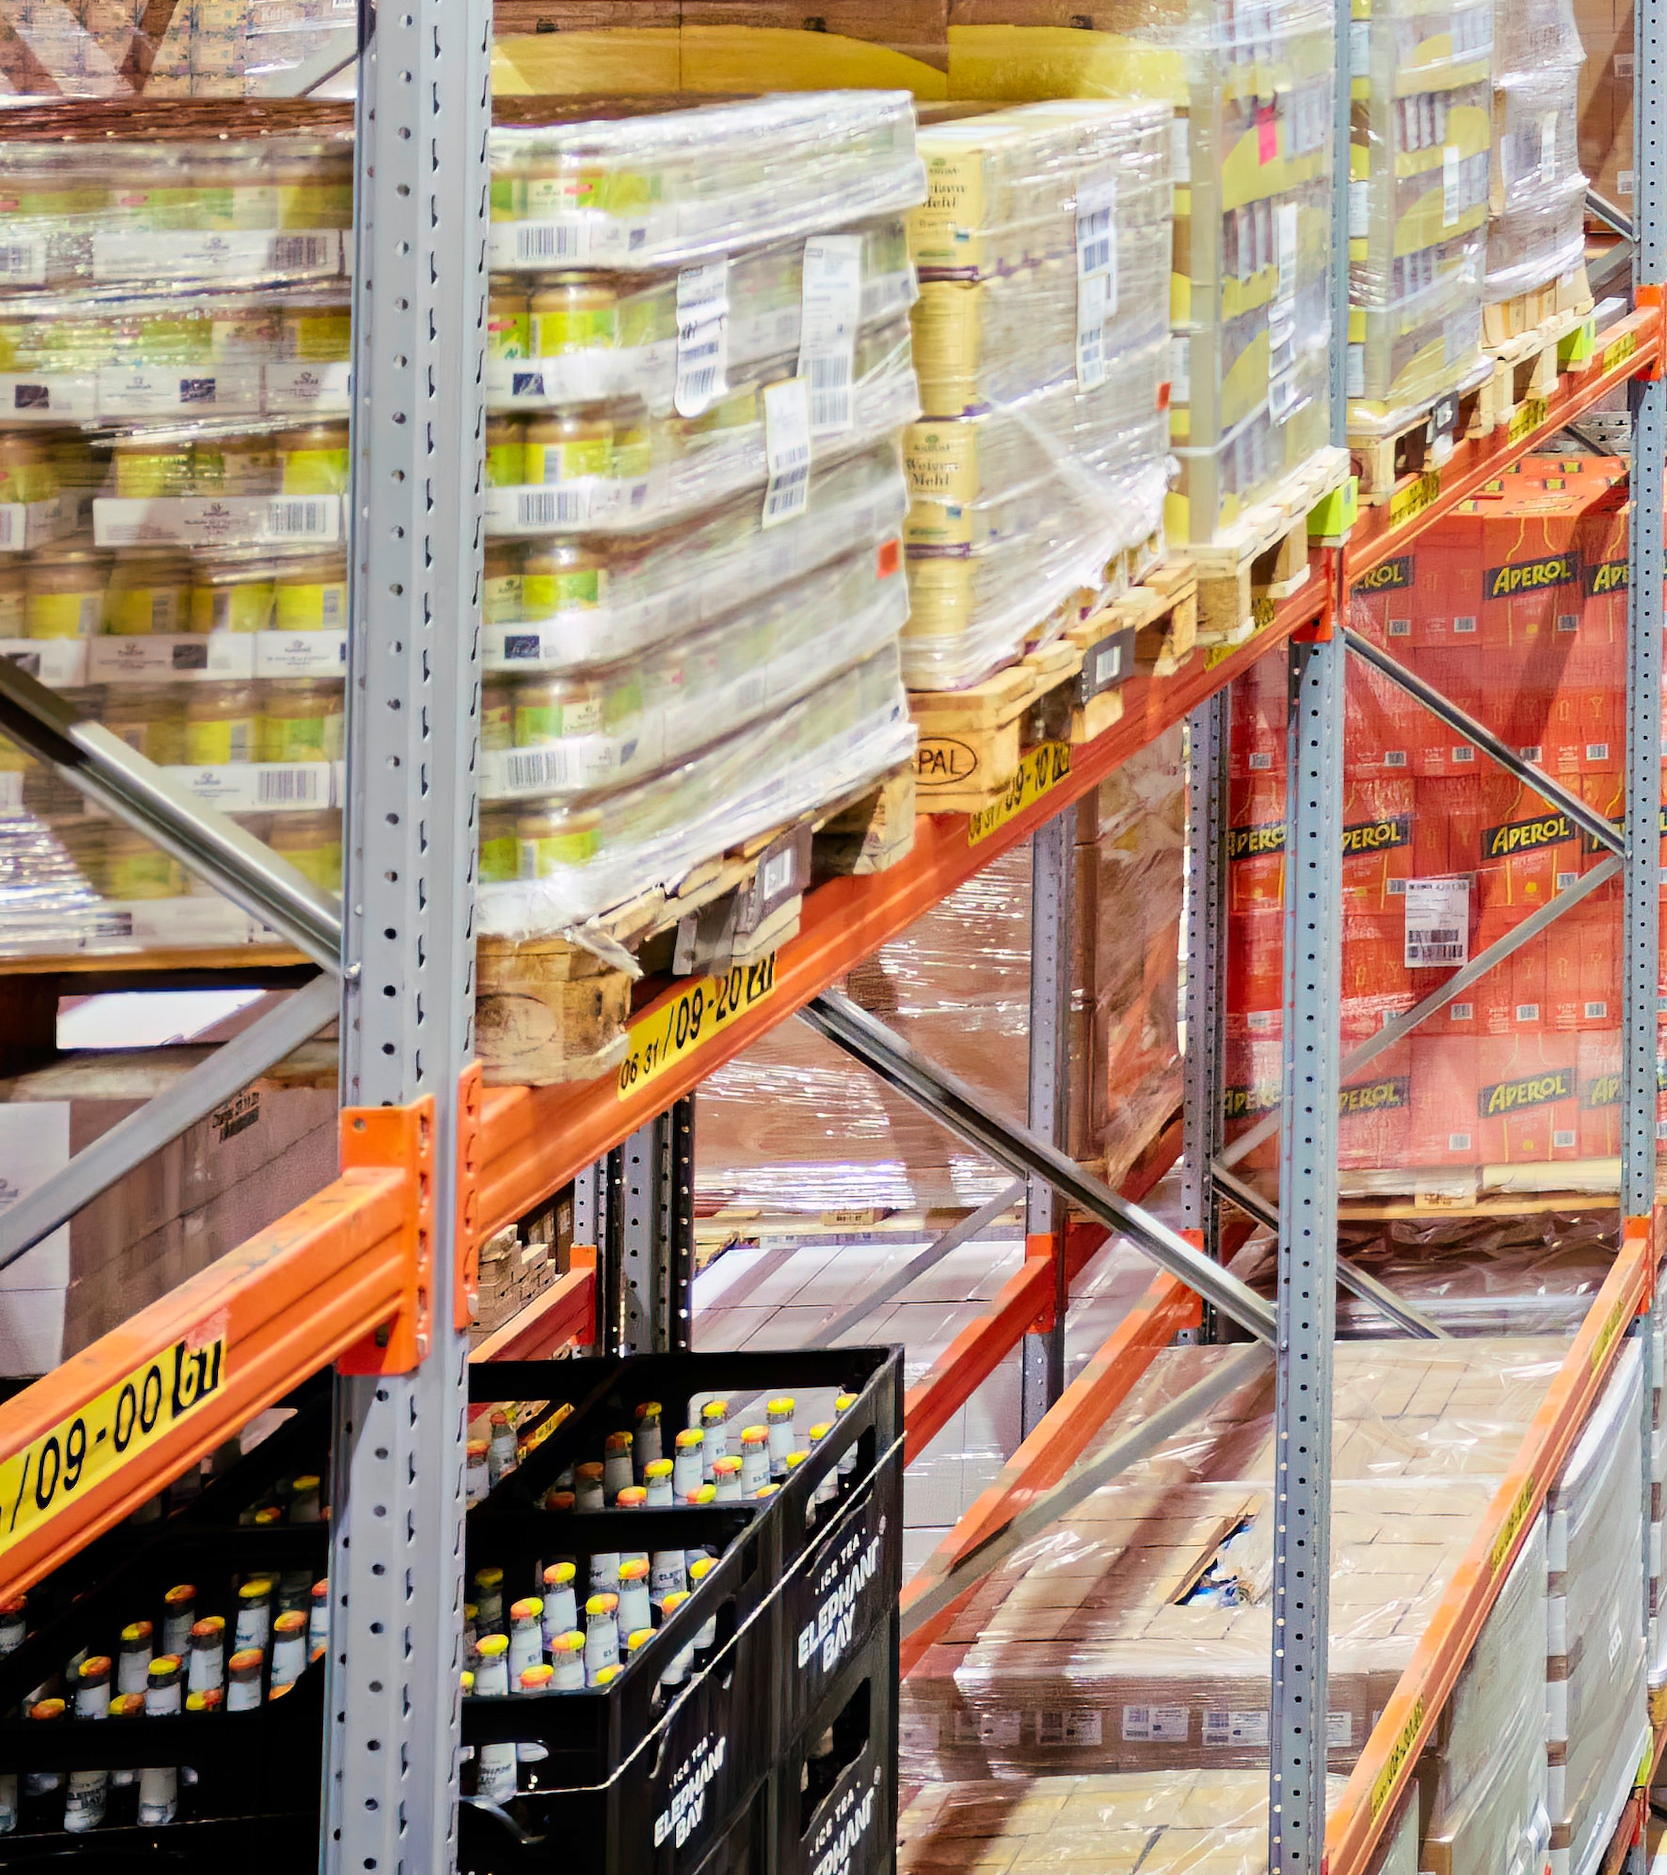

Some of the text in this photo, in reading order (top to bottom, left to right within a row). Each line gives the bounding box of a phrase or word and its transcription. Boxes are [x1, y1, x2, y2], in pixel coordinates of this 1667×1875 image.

[1493, 560, 1571, 596] APEROL
[913, 748, 963, 776] PAL
[1342, 822, 1401, 853] PEROL
[1491, 816, 1570, 855] APEROL
[620, 1052, 638, 1090] 06
[643, 1038, 660, 1075] 31
[1341, 1082, 1400, 1112] PEROL
[1488, 1074, 1567, 1113] APEROL
[797, 1535, 880, 1669] ELEPHANT
[822, 1601, 857, 1673] BAY
[654, 1736, 726, 1848] ELEPHANT
[675, 1790, 706, 1849] BAY
